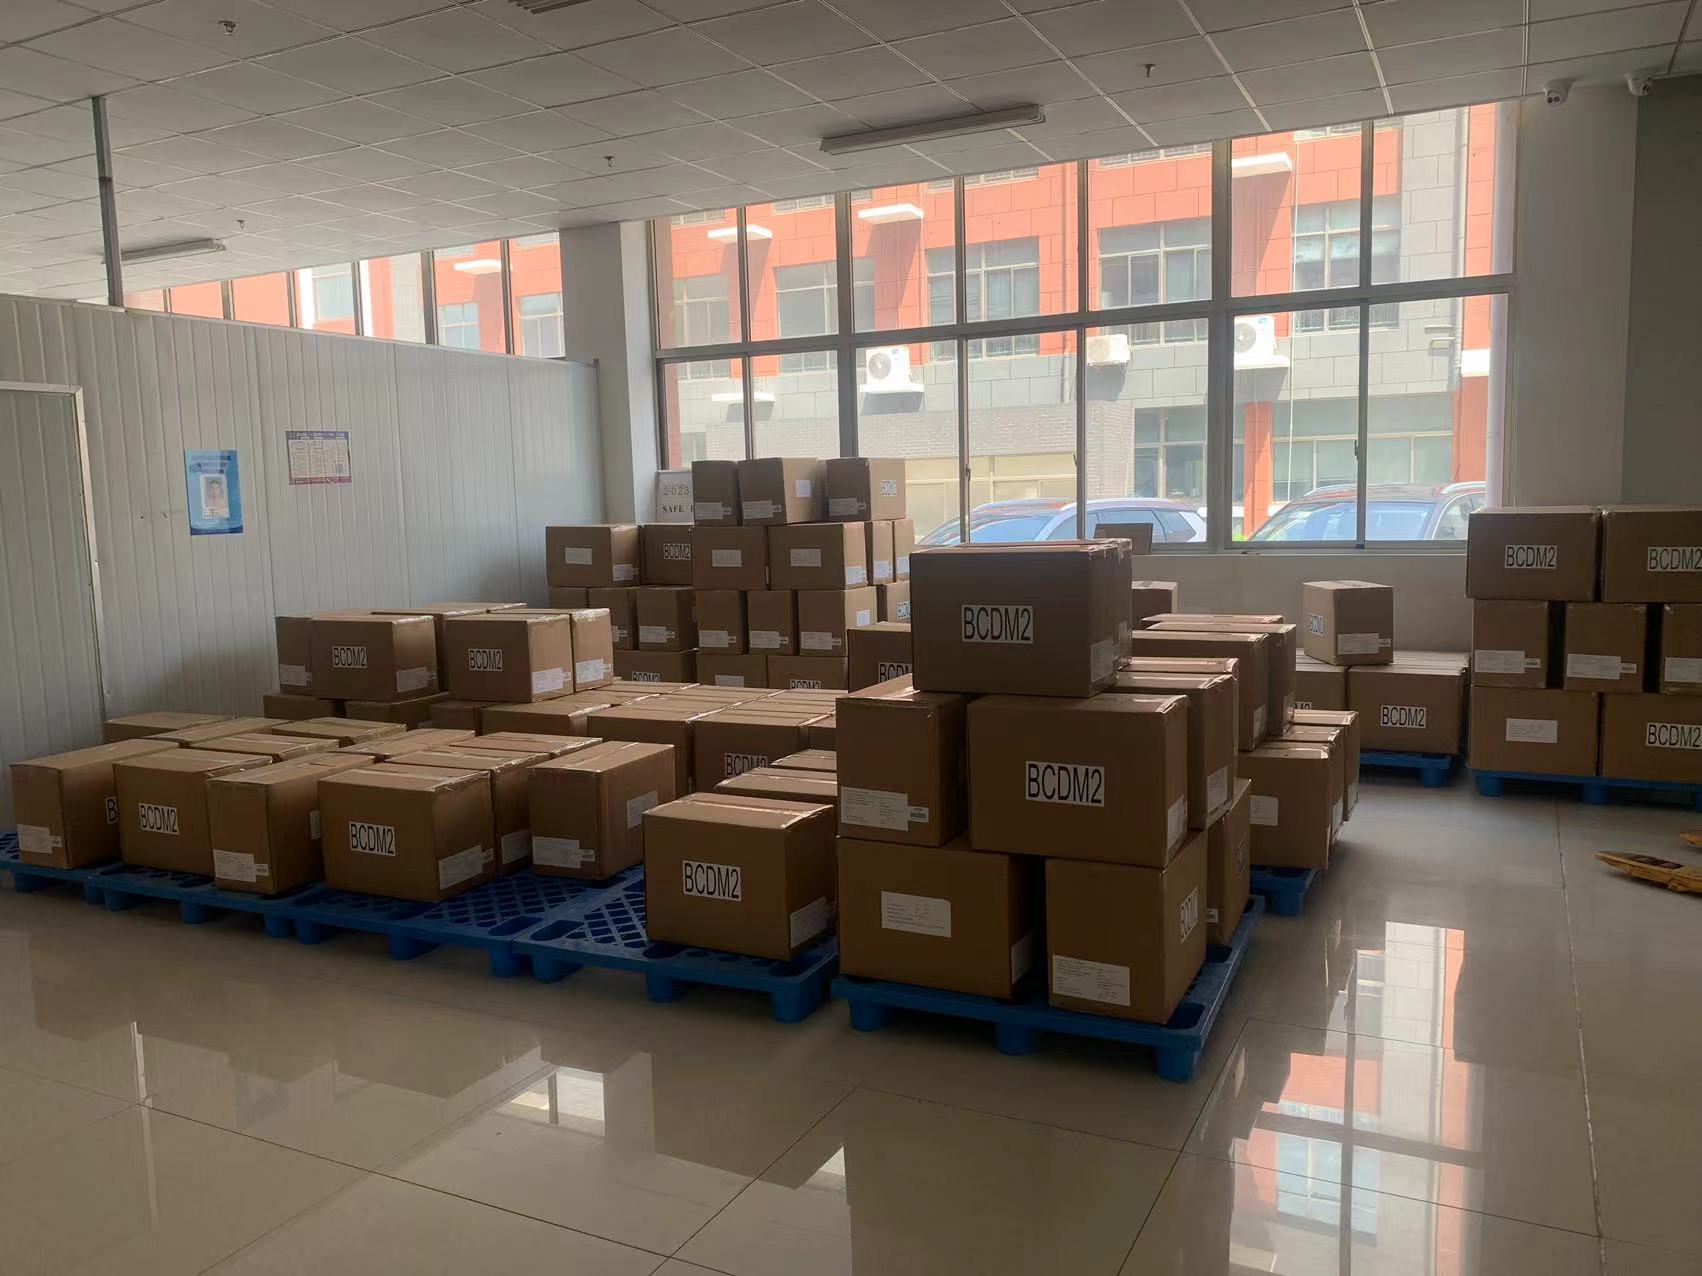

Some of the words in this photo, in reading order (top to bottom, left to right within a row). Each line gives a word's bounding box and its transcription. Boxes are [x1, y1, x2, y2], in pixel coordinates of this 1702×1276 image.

[664, 486, 690, 496] 2023
[662, 504, 684, 513] SAFE
[664, 544, 691, 559] BCDM2
[1506, 546, 1556, 568] BCDM2
[1649, 548, 1702, 570] BCDM2
[963, 606, 1031, 641] BCDM2
[333, 647, 367, 667] BCDM2
[470, 650, 502, 670] BCDM2
[879, 663, 909, 683] BCD
[1381, 706, 1425, 727] BCDM2
[1648, 724, 1701, 748] BCDM2
[1028, 763, 1103, 804] BCDM2
[140, 805, 178, 833] BCDM2
[350, 823, 395, 855] BCDM2
[684, 862, 740, 899] BCDM2
